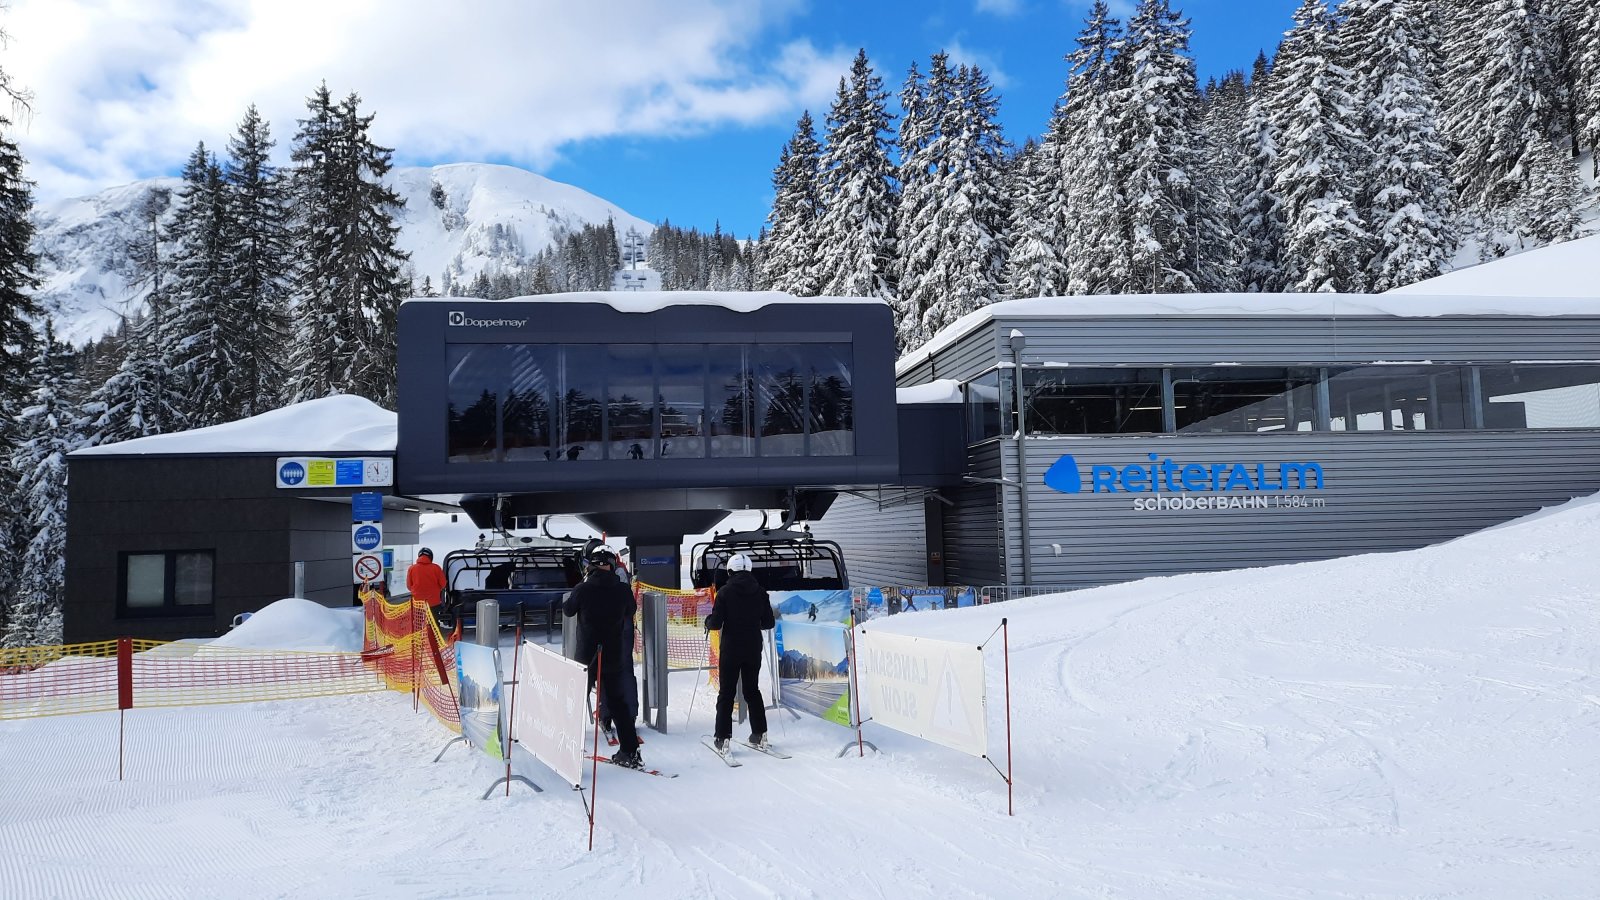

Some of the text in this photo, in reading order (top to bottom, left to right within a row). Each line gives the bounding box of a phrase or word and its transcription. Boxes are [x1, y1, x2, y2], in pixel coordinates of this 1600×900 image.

[465, 318, 527, 328] Doppelmayr
[1133, 493, 1325, 511] schoberBAHN 1.584 m
